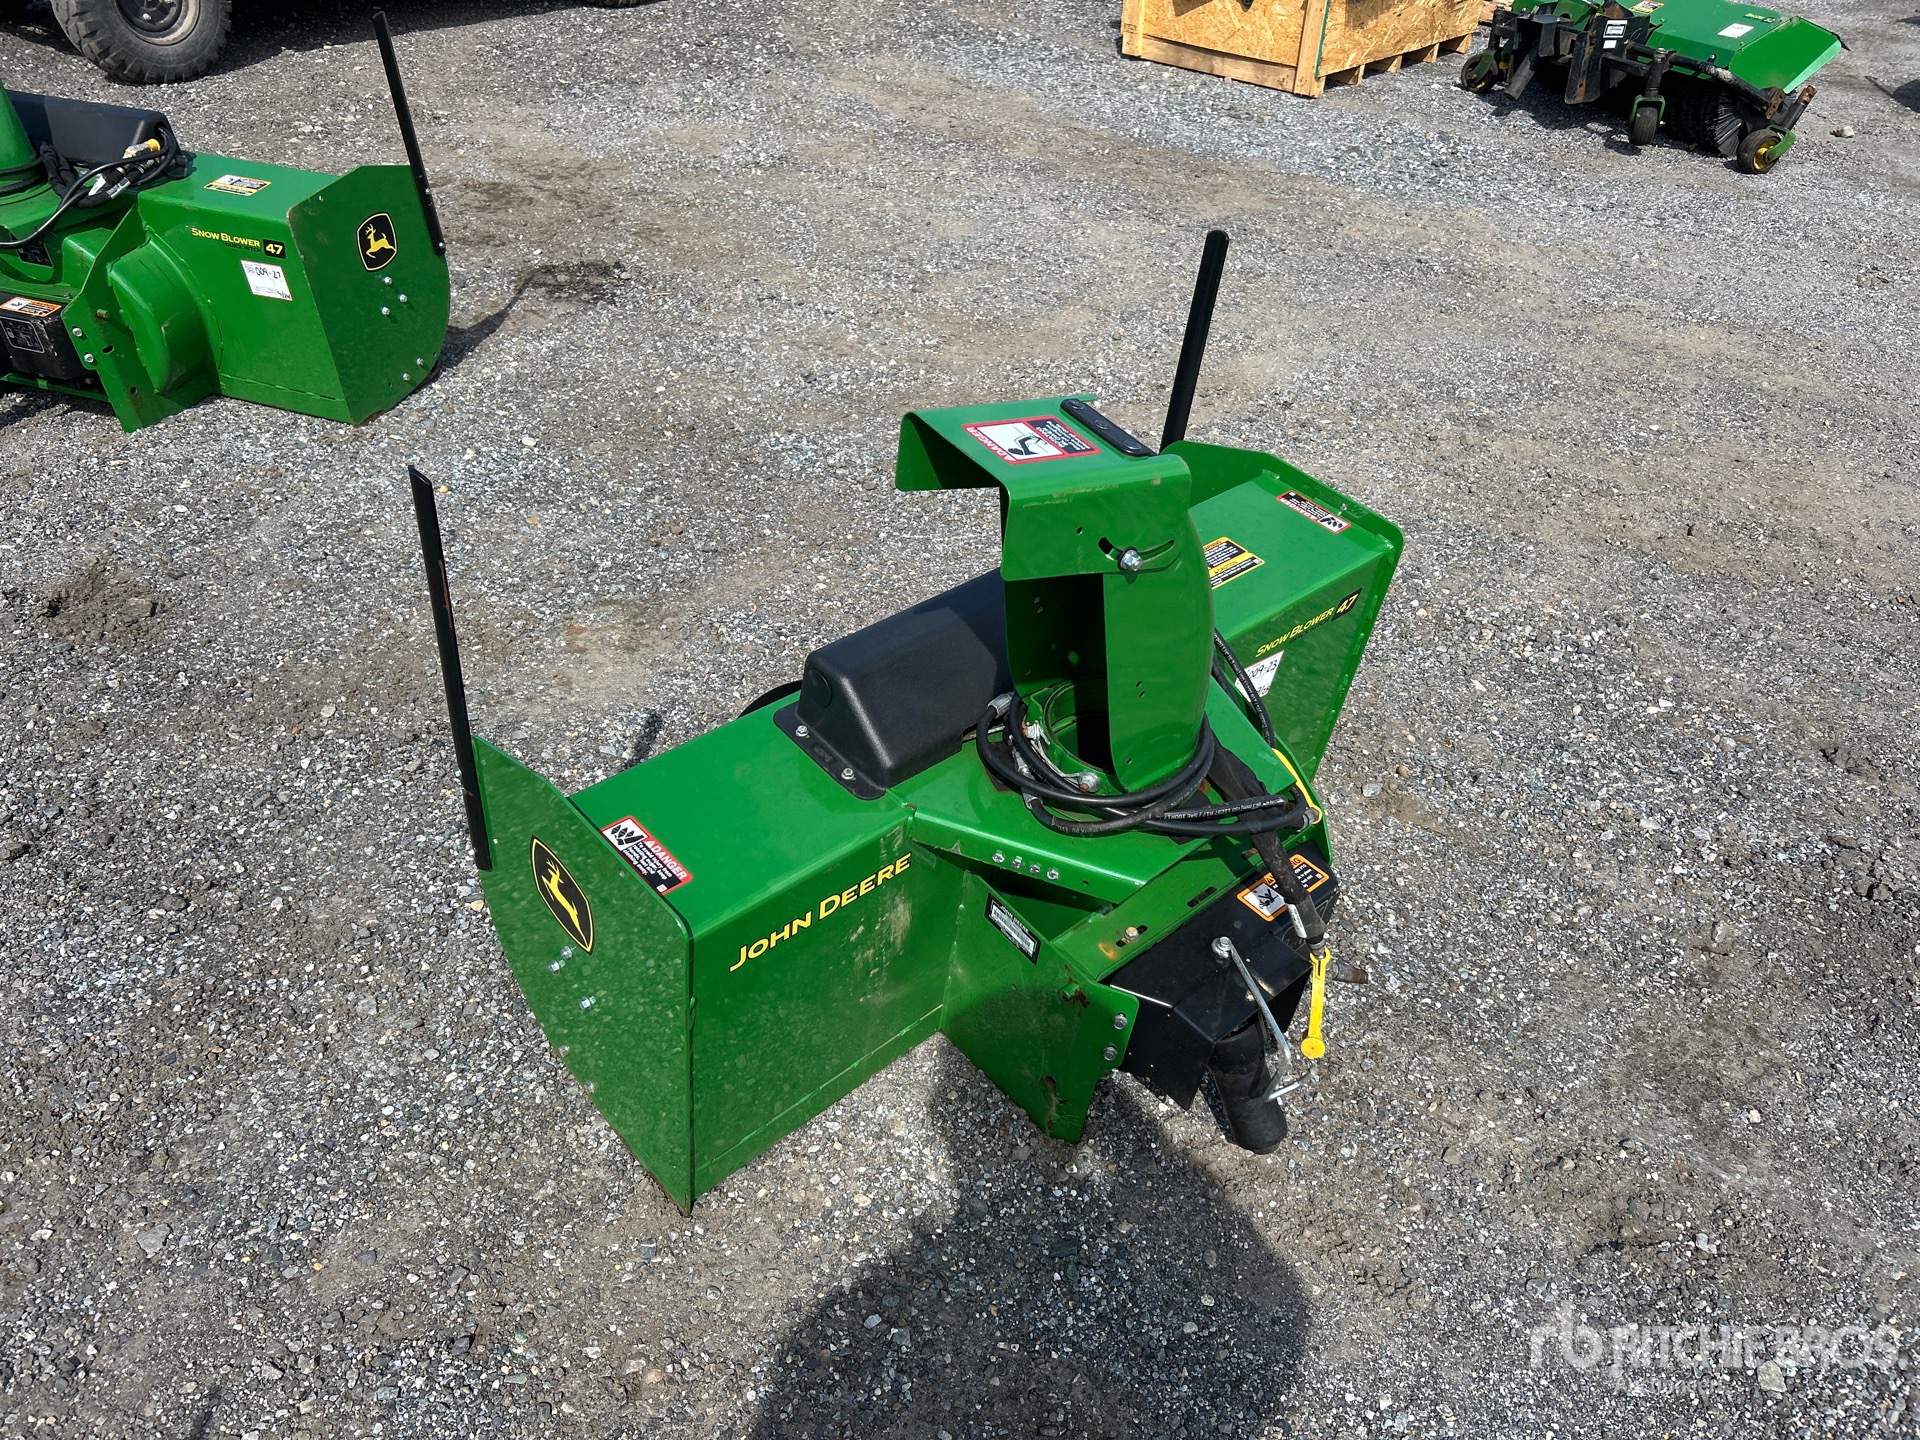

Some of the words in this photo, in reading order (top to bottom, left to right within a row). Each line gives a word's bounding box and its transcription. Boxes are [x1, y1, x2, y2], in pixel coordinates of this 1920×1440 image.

[191, 227, 220, 240] SNOW
[221, 232, 261, 248] BLOWER
[266, 244, 283, 255] 47
[965, 426, 1008, 455] DANGER
[1255, 631, 1290, 658] SNOW
[1290, 606, 1335, 639] BLOWER
[1336, 593, 1359, 614] 47
[650, 845, 688, 880] DANGER
[729, 911, 812, 973] JOHN
[819, 852, 912, 920] DEERE
